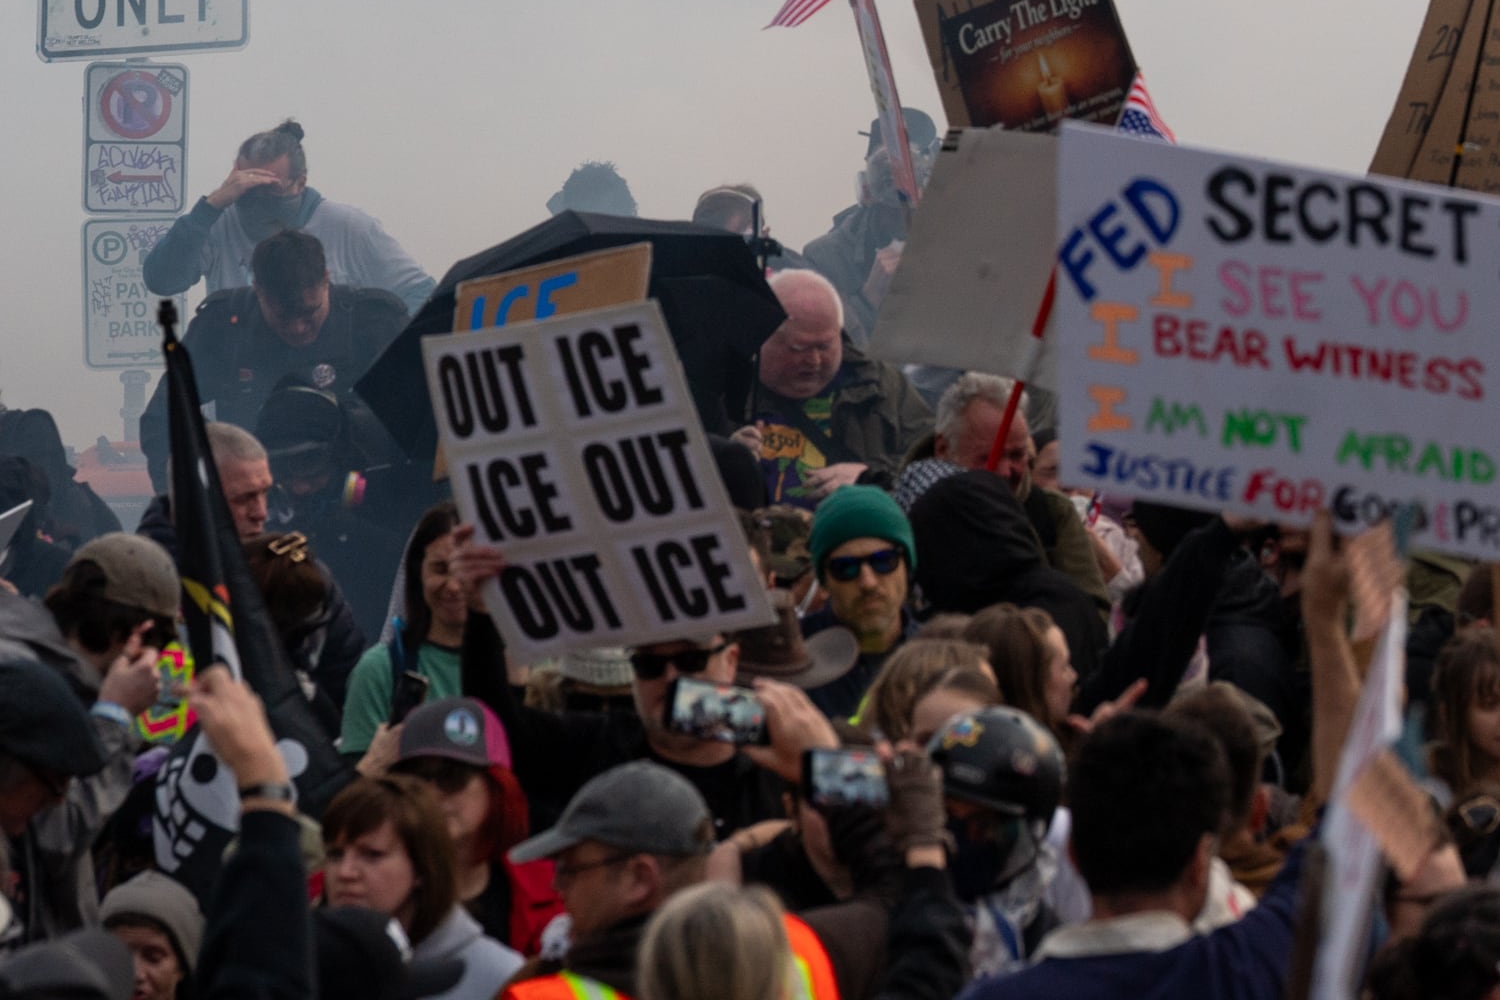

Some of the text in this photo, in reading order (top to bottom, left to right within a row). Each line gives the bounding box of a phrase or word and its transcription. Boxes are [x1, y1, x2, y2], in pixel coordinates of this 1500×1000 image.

[958, 17, 1012, 55] Carry
[1059, 176, 1182, 302] FED
[1206, 166, 1481, 264] SECRET
[120, 302, 147, 318] TO
[1148, 252, 1470, 333] I SEE YOU
[438, 323, 663, 439] OUT ICE
[1087, 304, 1486, 402] I BEAR WITNESS
[1081, 441, 1237, 501] JUSTICE
[1243, 467, 1327, 514] FOR
[1086, 385, 1496, 485] I AM NOT AFRAID
[466, 428, 704, 542] ICE OUT
[501, 533, 747, 642] OUT ICE
